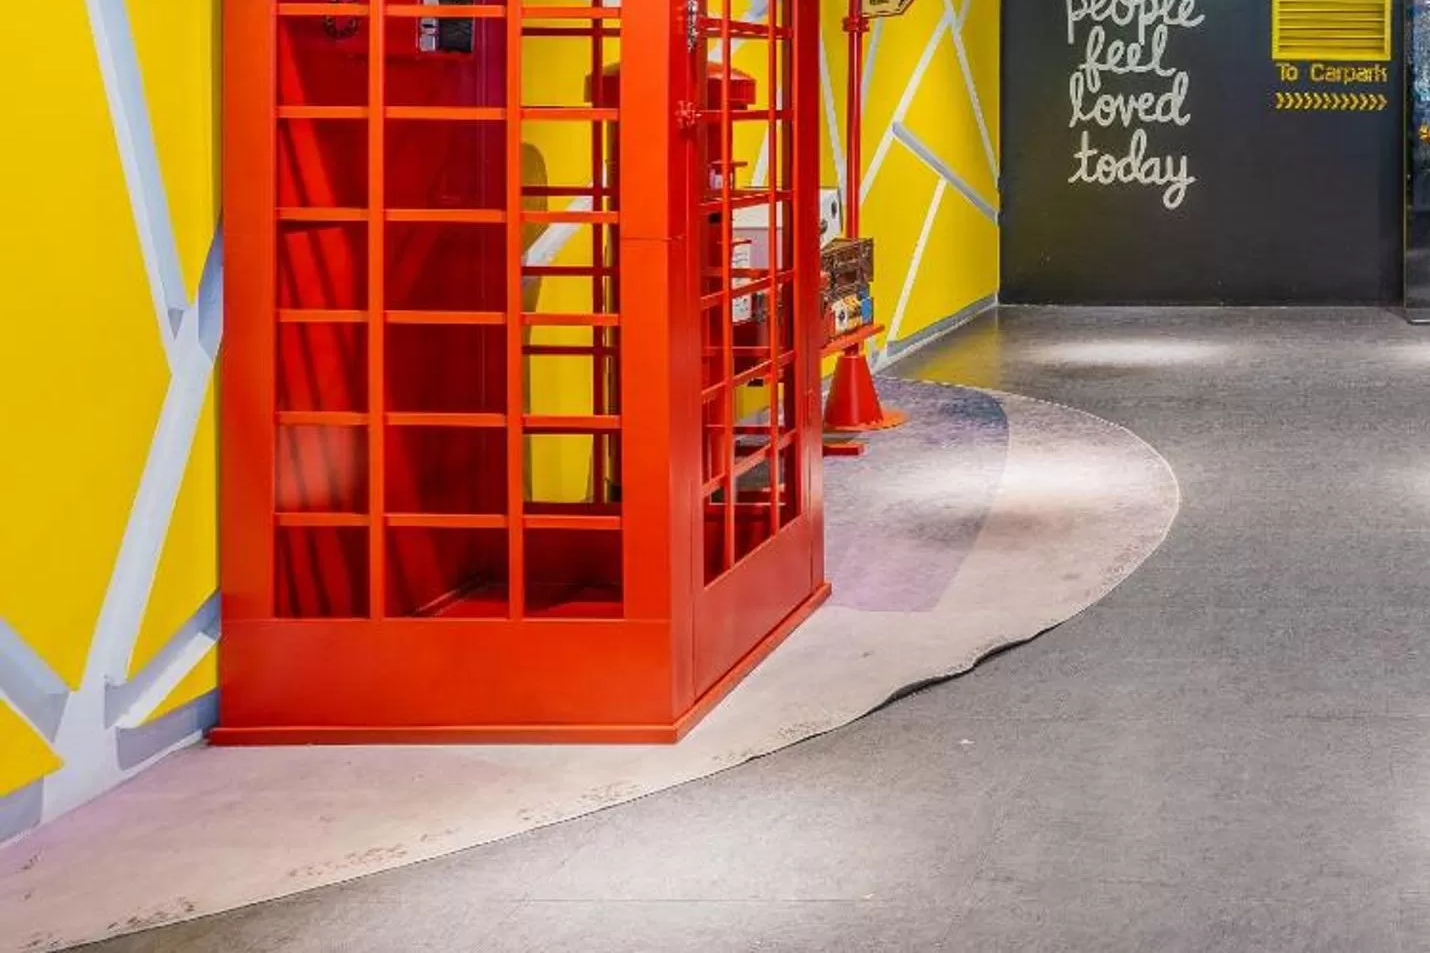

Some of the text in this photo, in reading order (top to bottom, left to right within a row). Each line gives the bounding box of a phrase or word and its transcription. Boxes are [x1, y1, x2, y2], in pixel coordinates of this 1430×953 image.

[1079, 23, 1177, 94] feel
[1276, 62, 1388, 86] To Carpark
[1068, 70, 1192, 129] loved
[1067, 128, 1196, 209] today
